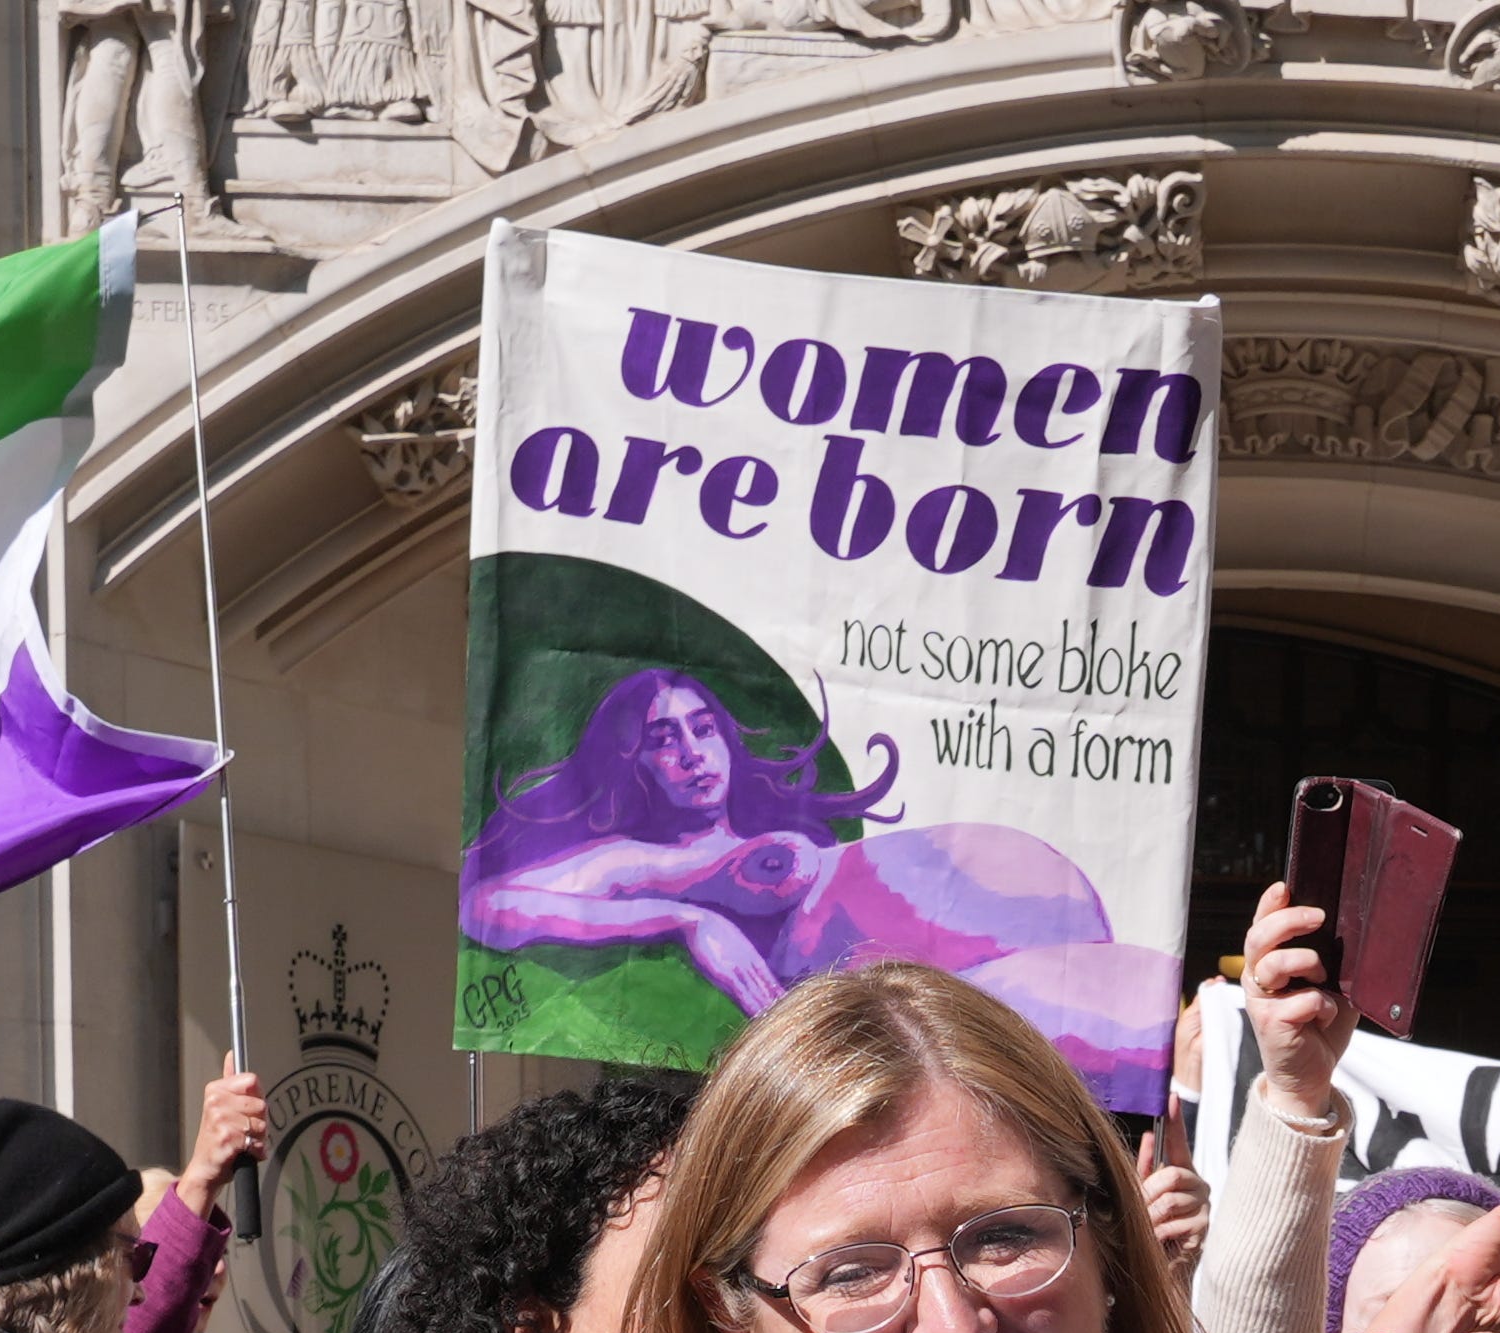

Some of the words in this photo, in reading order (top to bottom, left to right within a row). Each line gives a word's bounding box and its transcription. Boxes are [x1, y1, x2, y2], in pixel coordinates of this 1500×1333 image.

[620, 306, 1203, 464] women
[510, 426, 779, 540] are
[810, 434, 1195, 597] born
[840, 619, 911, 676] not
[921, 630, 1045, 686] some
[1058, 618, 1182, 701] bloke
[930, 698, 1012, 773] with
[1028, 729, 1056, 778] a
[1070, 719, 1173, 785] form
[266, 1073, 388, 1144] UPREME
